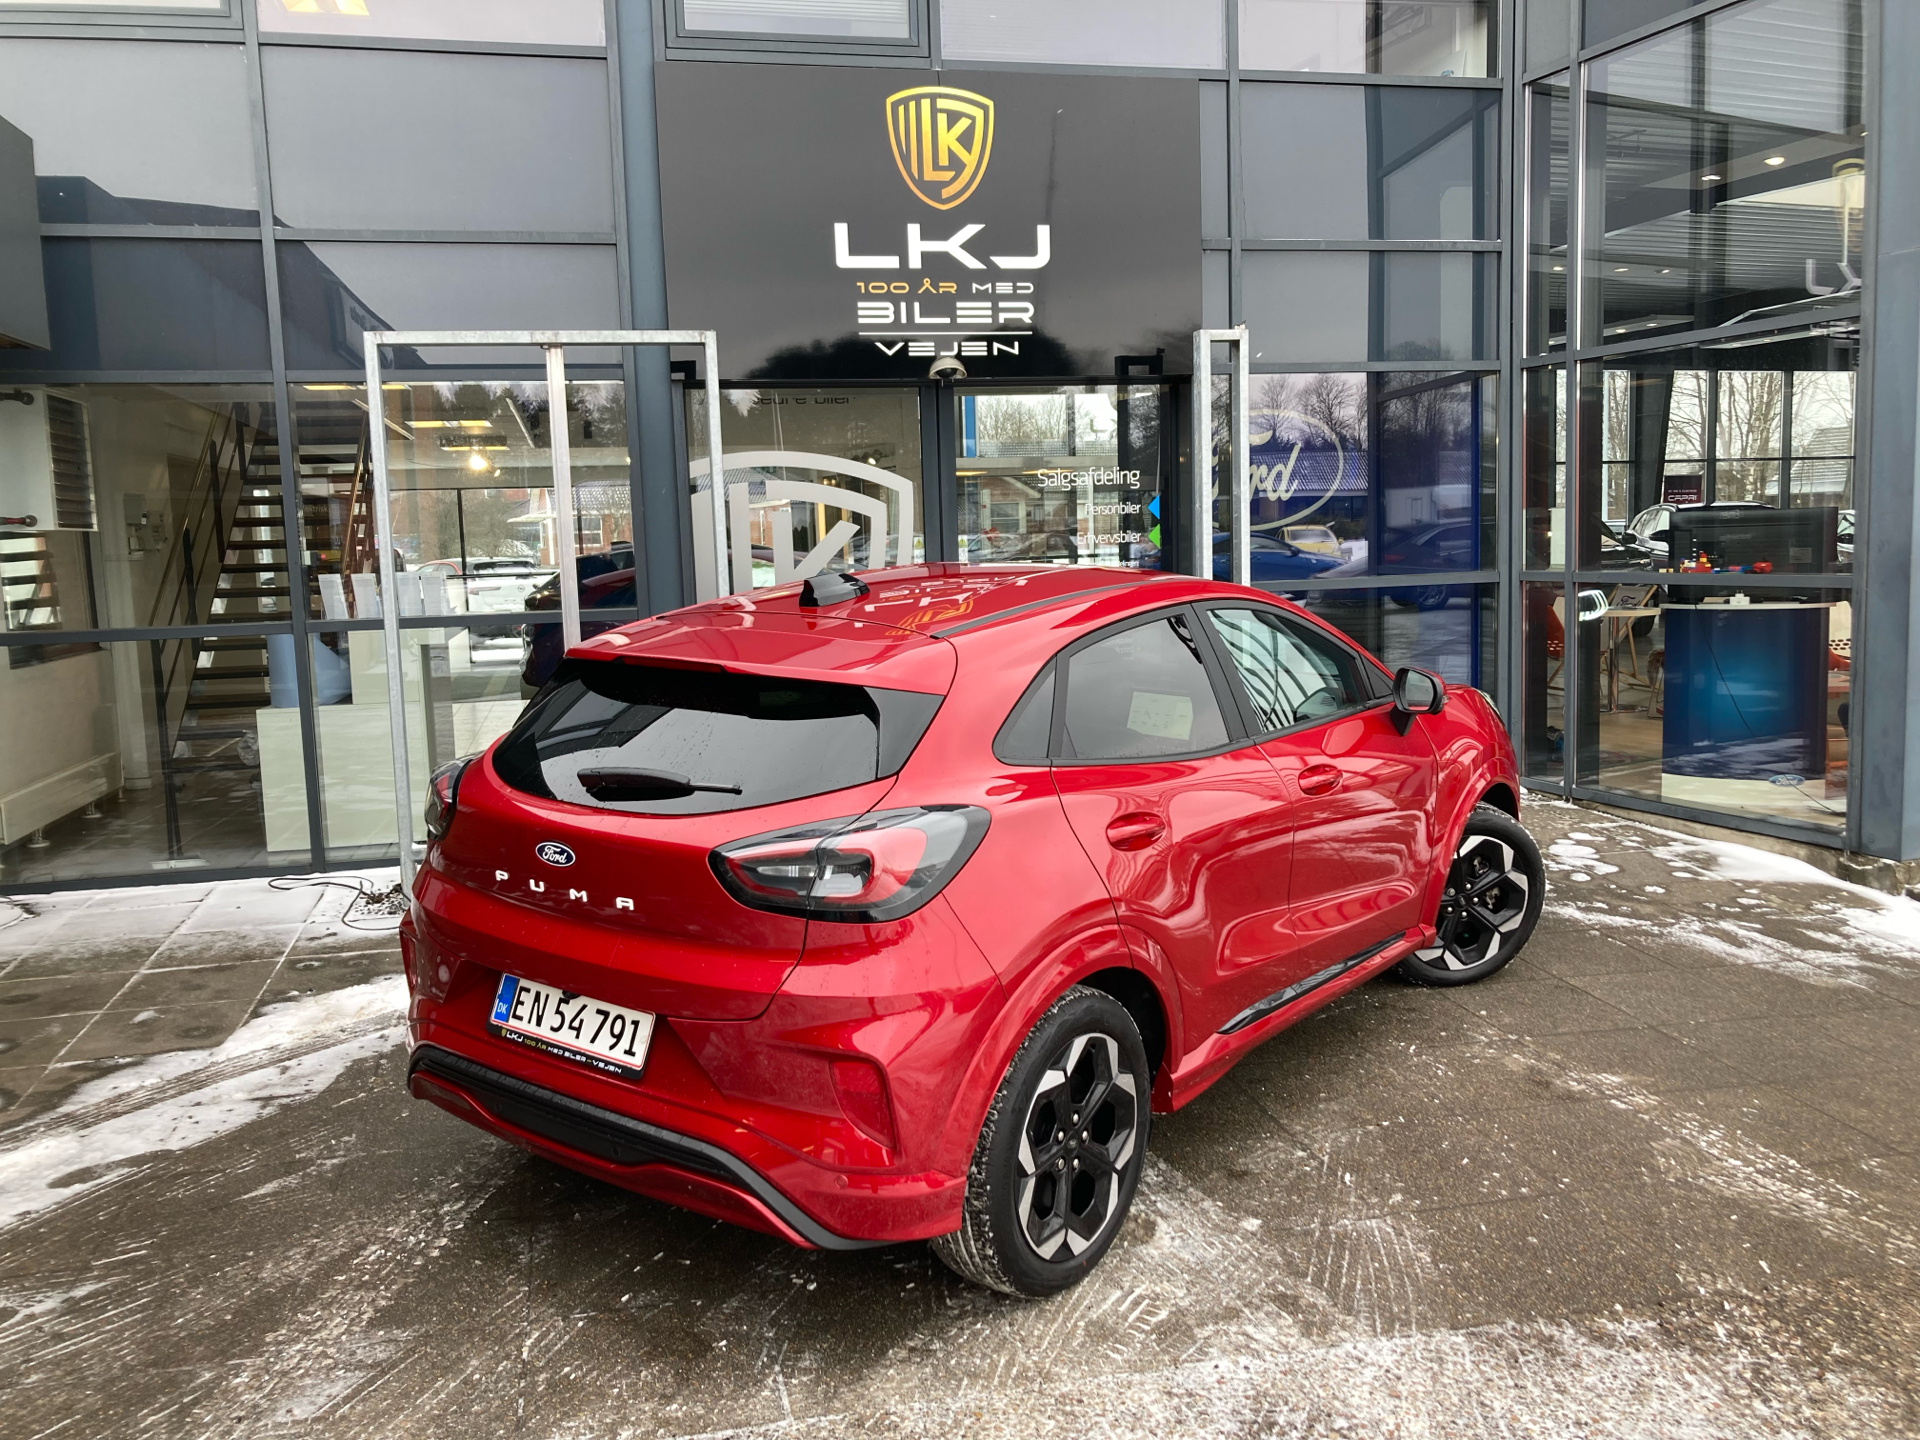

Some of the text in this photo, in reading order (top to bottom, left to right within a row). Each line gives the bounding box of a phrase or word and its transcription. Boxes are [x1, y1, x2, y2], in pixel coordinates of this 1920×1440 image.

[834, 222, 1051, 269] LKJ
[856, 277, 1034, 294] 100 ÅR MED
[857, 301, 1035, 324] BILER
[874, 341, 1019, 357] VEJEN
[1037, 466, 1141, 491] Salgsafdeling
[1084, 501, 1141, 516] Personbiler
[1077, 530, 1142, 545] Erhvervsbiler
[542, 845, 568, 864] Ford
[495, 870, 635, 911] PUMA
[496, 1001, 507, 1015] DK
[506, 1031, 523, 1043] LKJ
[563, 1052, 587, 1063] BILER
[592, 1059, 622, 1074] VEJEN
